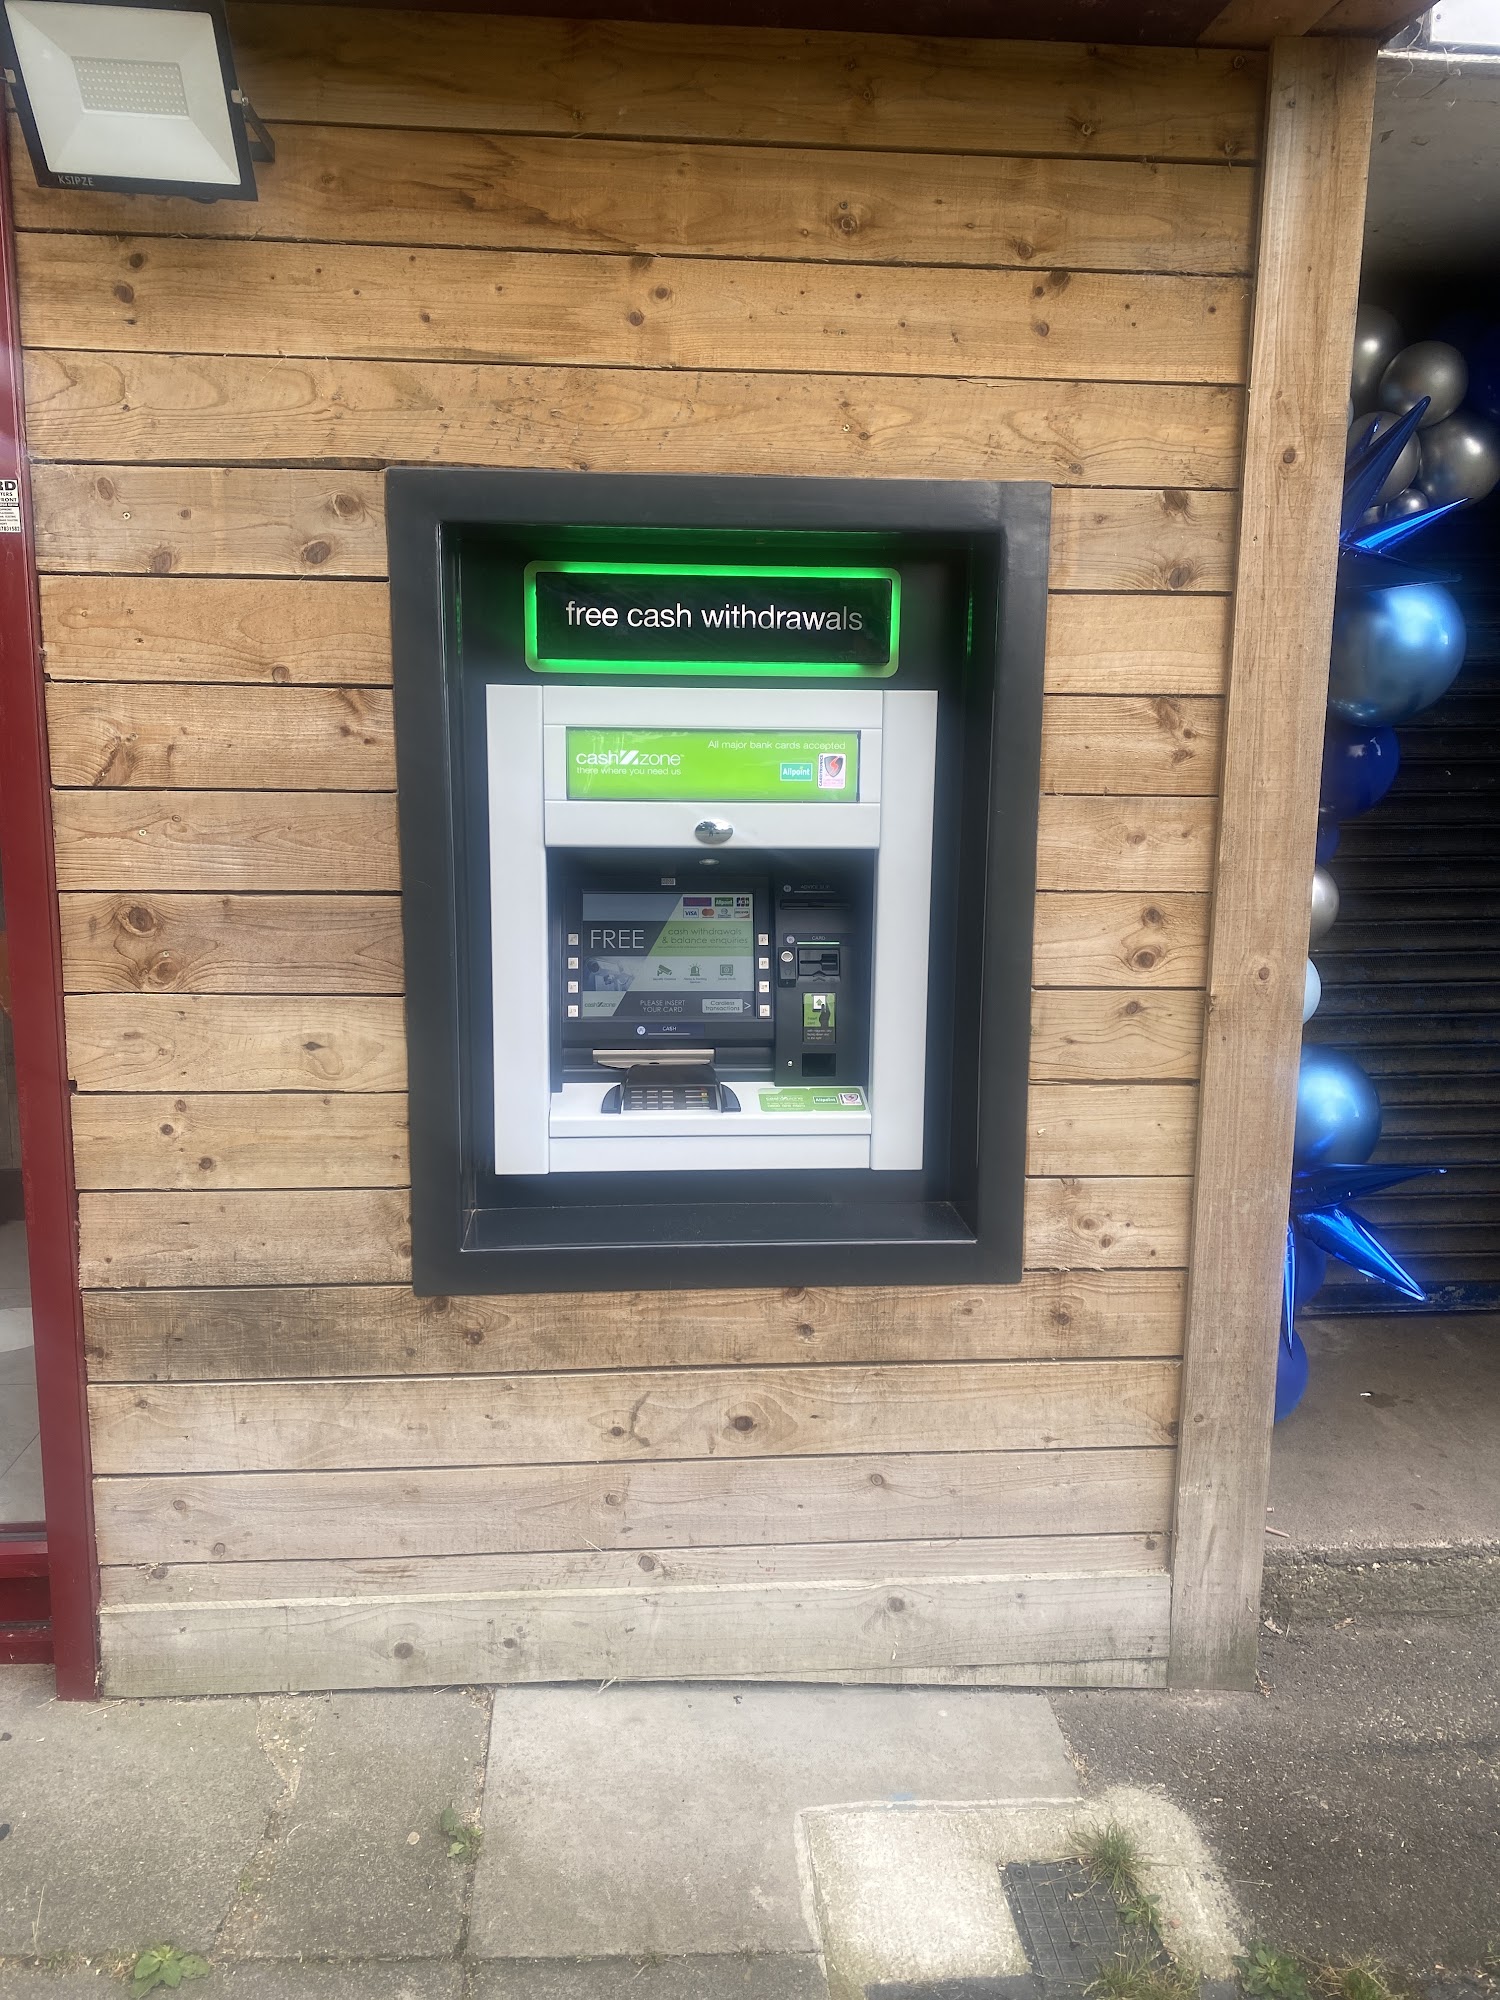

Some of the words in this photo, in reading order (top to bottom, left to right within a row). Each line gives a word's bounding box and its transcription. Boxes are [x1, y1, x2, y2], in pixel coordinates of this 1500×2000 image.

[58, 175, 95, 186] KSIPZE
[566, 601, 618, 627] free
[627, 603, 692, 628] cash
[701, 604, 863, 631] withdrawals
[708, 740, 719, 748] All
[722, 740, 746, 750] major
[750, 740, 772, 749] bank
[775, 741, 800, 750] cards
[803, 742, 846, 751] accepted
[601, 767, 627, 775] where
[630, 768, 645, 776] you
[648, 767, 669, 775] need
[782, 766, 811, 777] Allpoint
[668, 928, 689, 936] cash
[691, 928, 742, 936] withdrawals
[590, 929, 645, 949] FREE
[710, 937, 748, 946] enquiries
